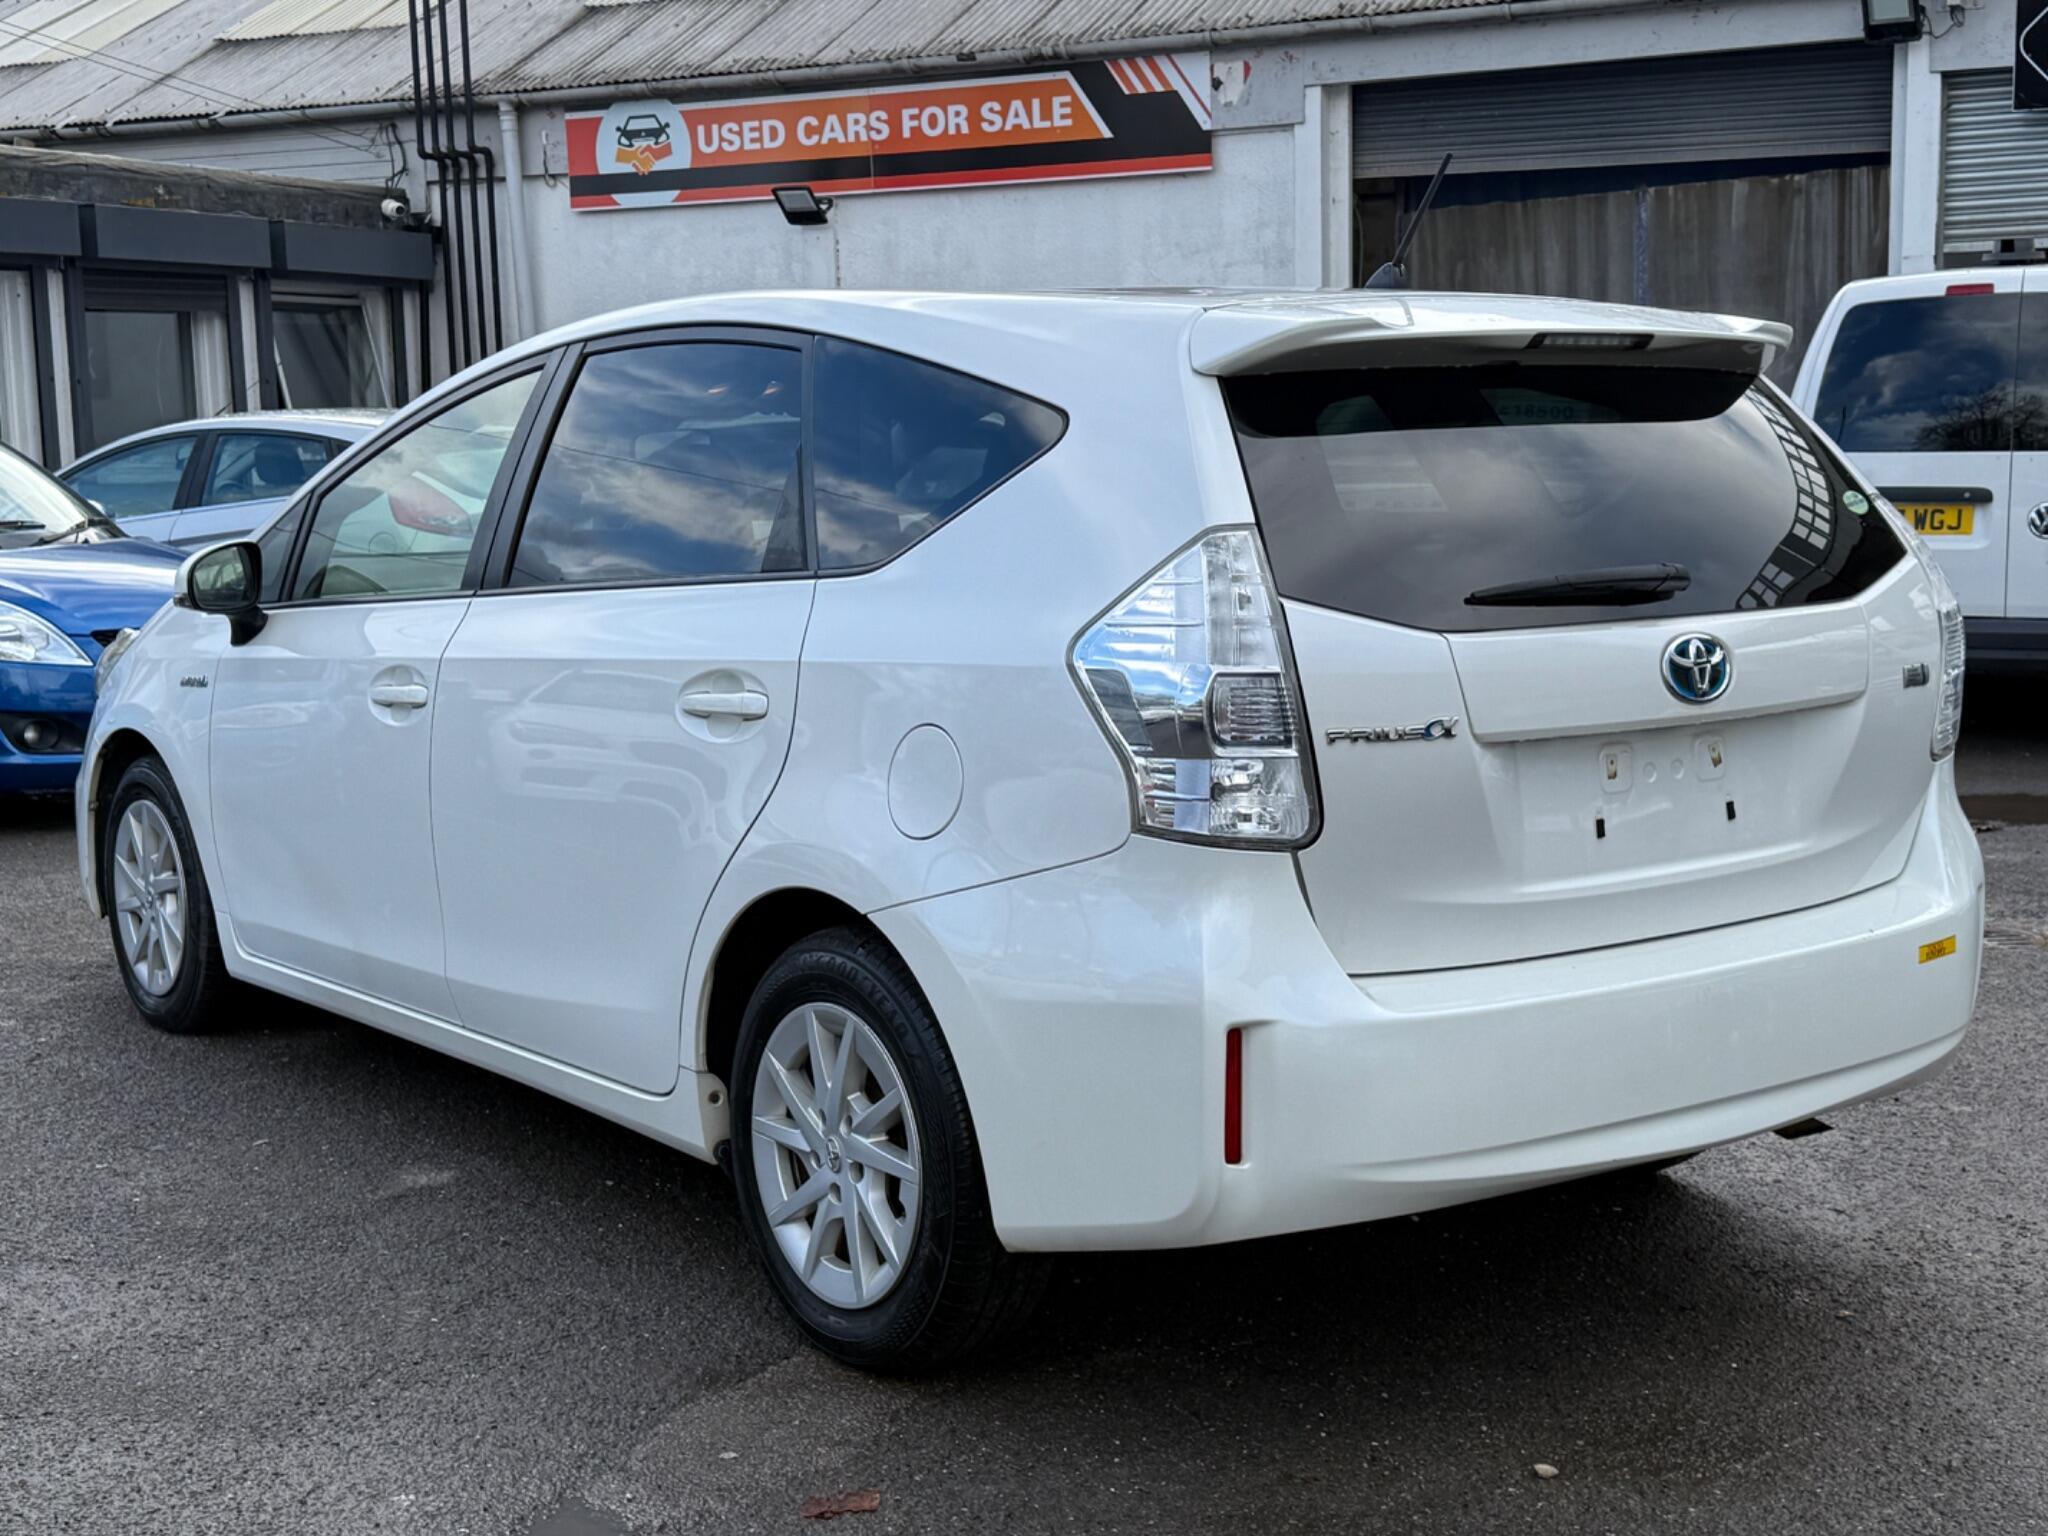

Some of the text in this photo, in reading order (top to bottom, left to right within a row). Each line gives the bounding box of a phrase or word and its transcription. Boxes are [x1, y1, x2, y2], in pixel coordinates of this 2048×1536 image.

[697, 95, 1073, 154] USED CARS FOR SALE
